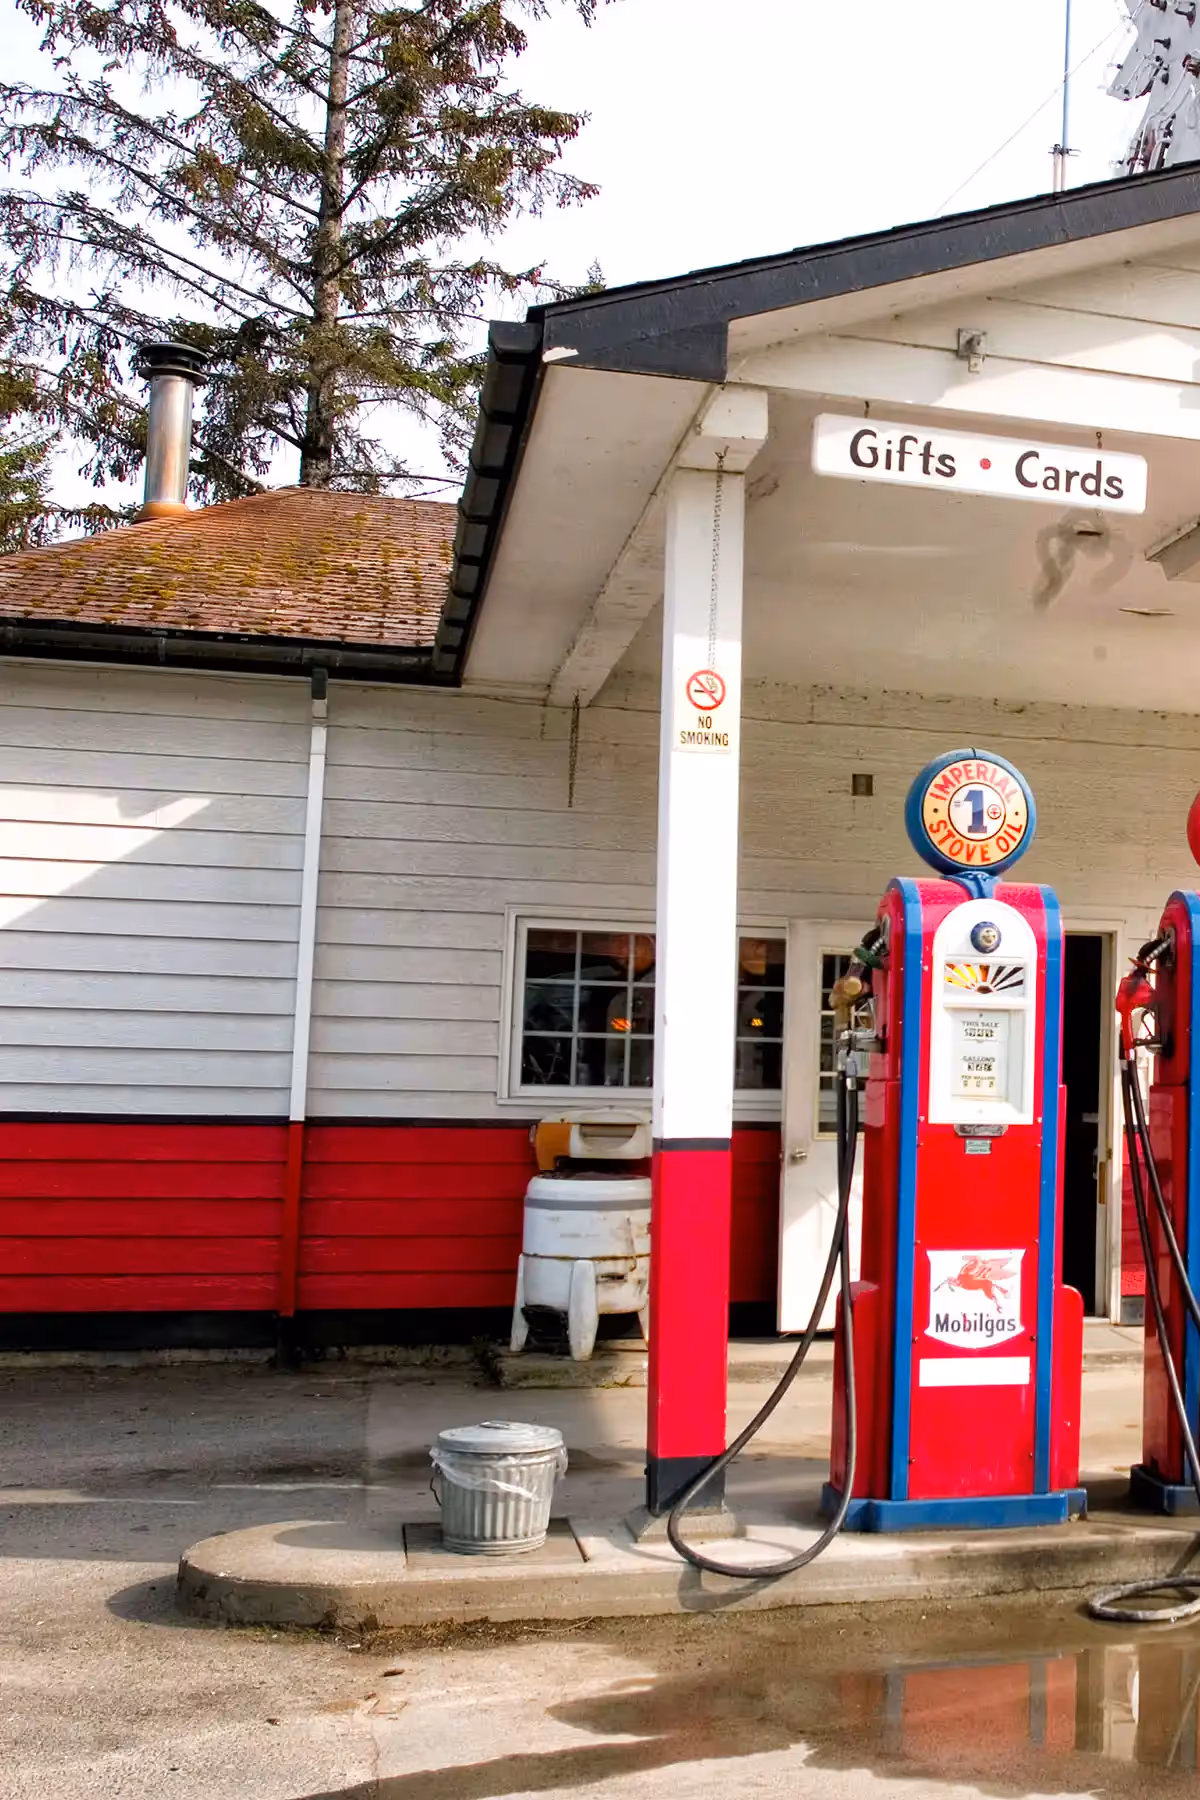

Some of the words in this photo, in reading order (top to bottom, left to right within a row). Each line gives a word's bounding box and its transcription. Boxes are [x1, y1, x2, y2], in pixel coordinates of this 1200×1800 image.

[849, 428, 957, 478] Gifts
[1015, 450, 1124, 499] Cards
[680, 730, 729, 746] SMOKING
[697, 715, 713, 729] NO
[929, 763, 1019, 804] IMPERIAL
[963, 789, 988, 834] 1
[929, 819, 991, 863] STOVE
[995, 823, 1023, 853] OIL
[935, 1312, 1016, 1338] Mobilgas
